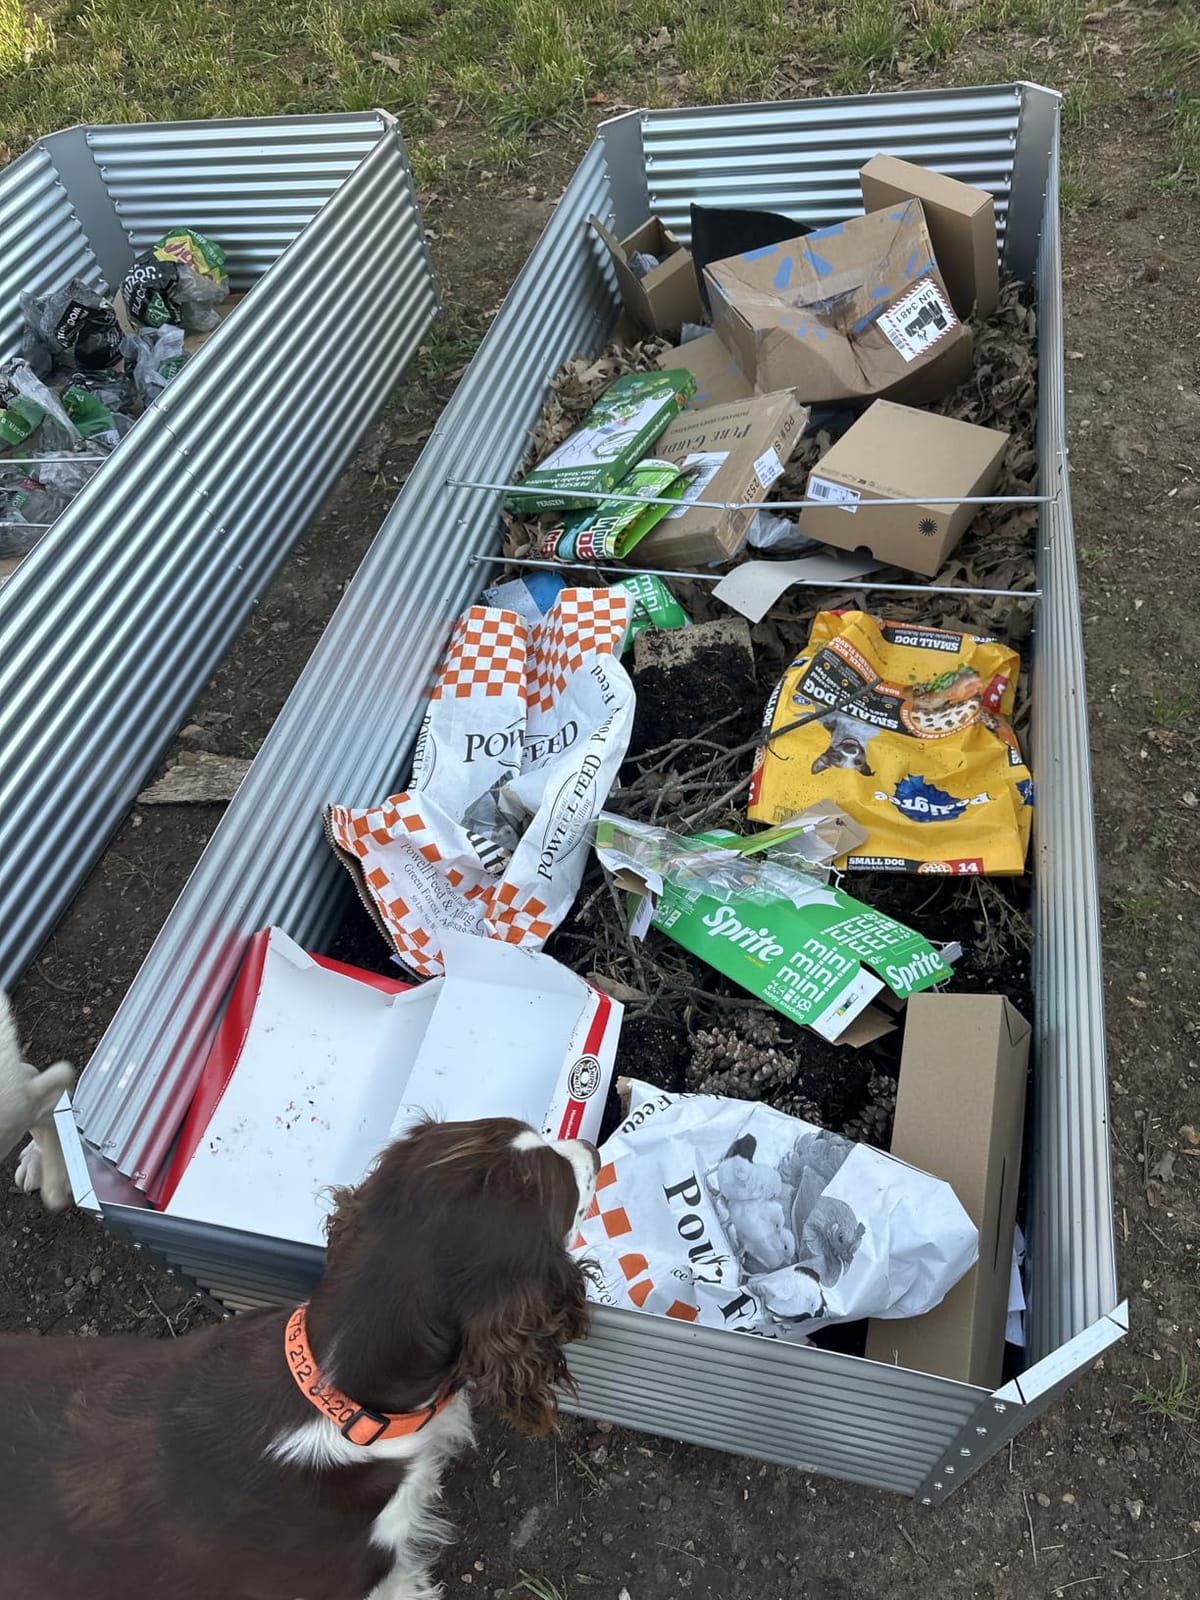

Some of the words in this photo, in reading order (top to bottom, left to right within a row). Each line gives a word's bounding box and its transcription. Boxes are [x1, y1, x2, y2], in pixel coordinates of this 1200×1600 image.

[896, 302, 918, 323] 3481
[918, 289, 935, 304] UN
[711, 423, 752, 443] PURE
[894, 635, 918, 645] DOG
[919, 638, 958, 651] SMALL
[591, 665, 614, 704] Feed
[803, 680, 836, 707] DOG
[537, 803, 580, 882] POWELL
[574, 754, 602, 798] FEED
[874, 791, 991, 816] Pedigree
[958, 863, 977, 872] 14
[402, 863, 426, 889] Green
[418, 888, 446, 919] Forest,
[425, 872, 450, 899] Feed
[441, 898, 454, 912] &
[702, 904, 785, 964] Sprite
[819, 926, 874, 957] mini
[834, 920, 887, 952] mini
[850, 915, 899, 945] mini
[788, 951, 840, 988] mini
[802, 938, 857, 976] mini
[885, 950, 944, 992] Sprite
[775, 965, 831, 1004] mini
[289, 1344, 312, 1383] 212
[309, 1386, 357, 1424] 8420
